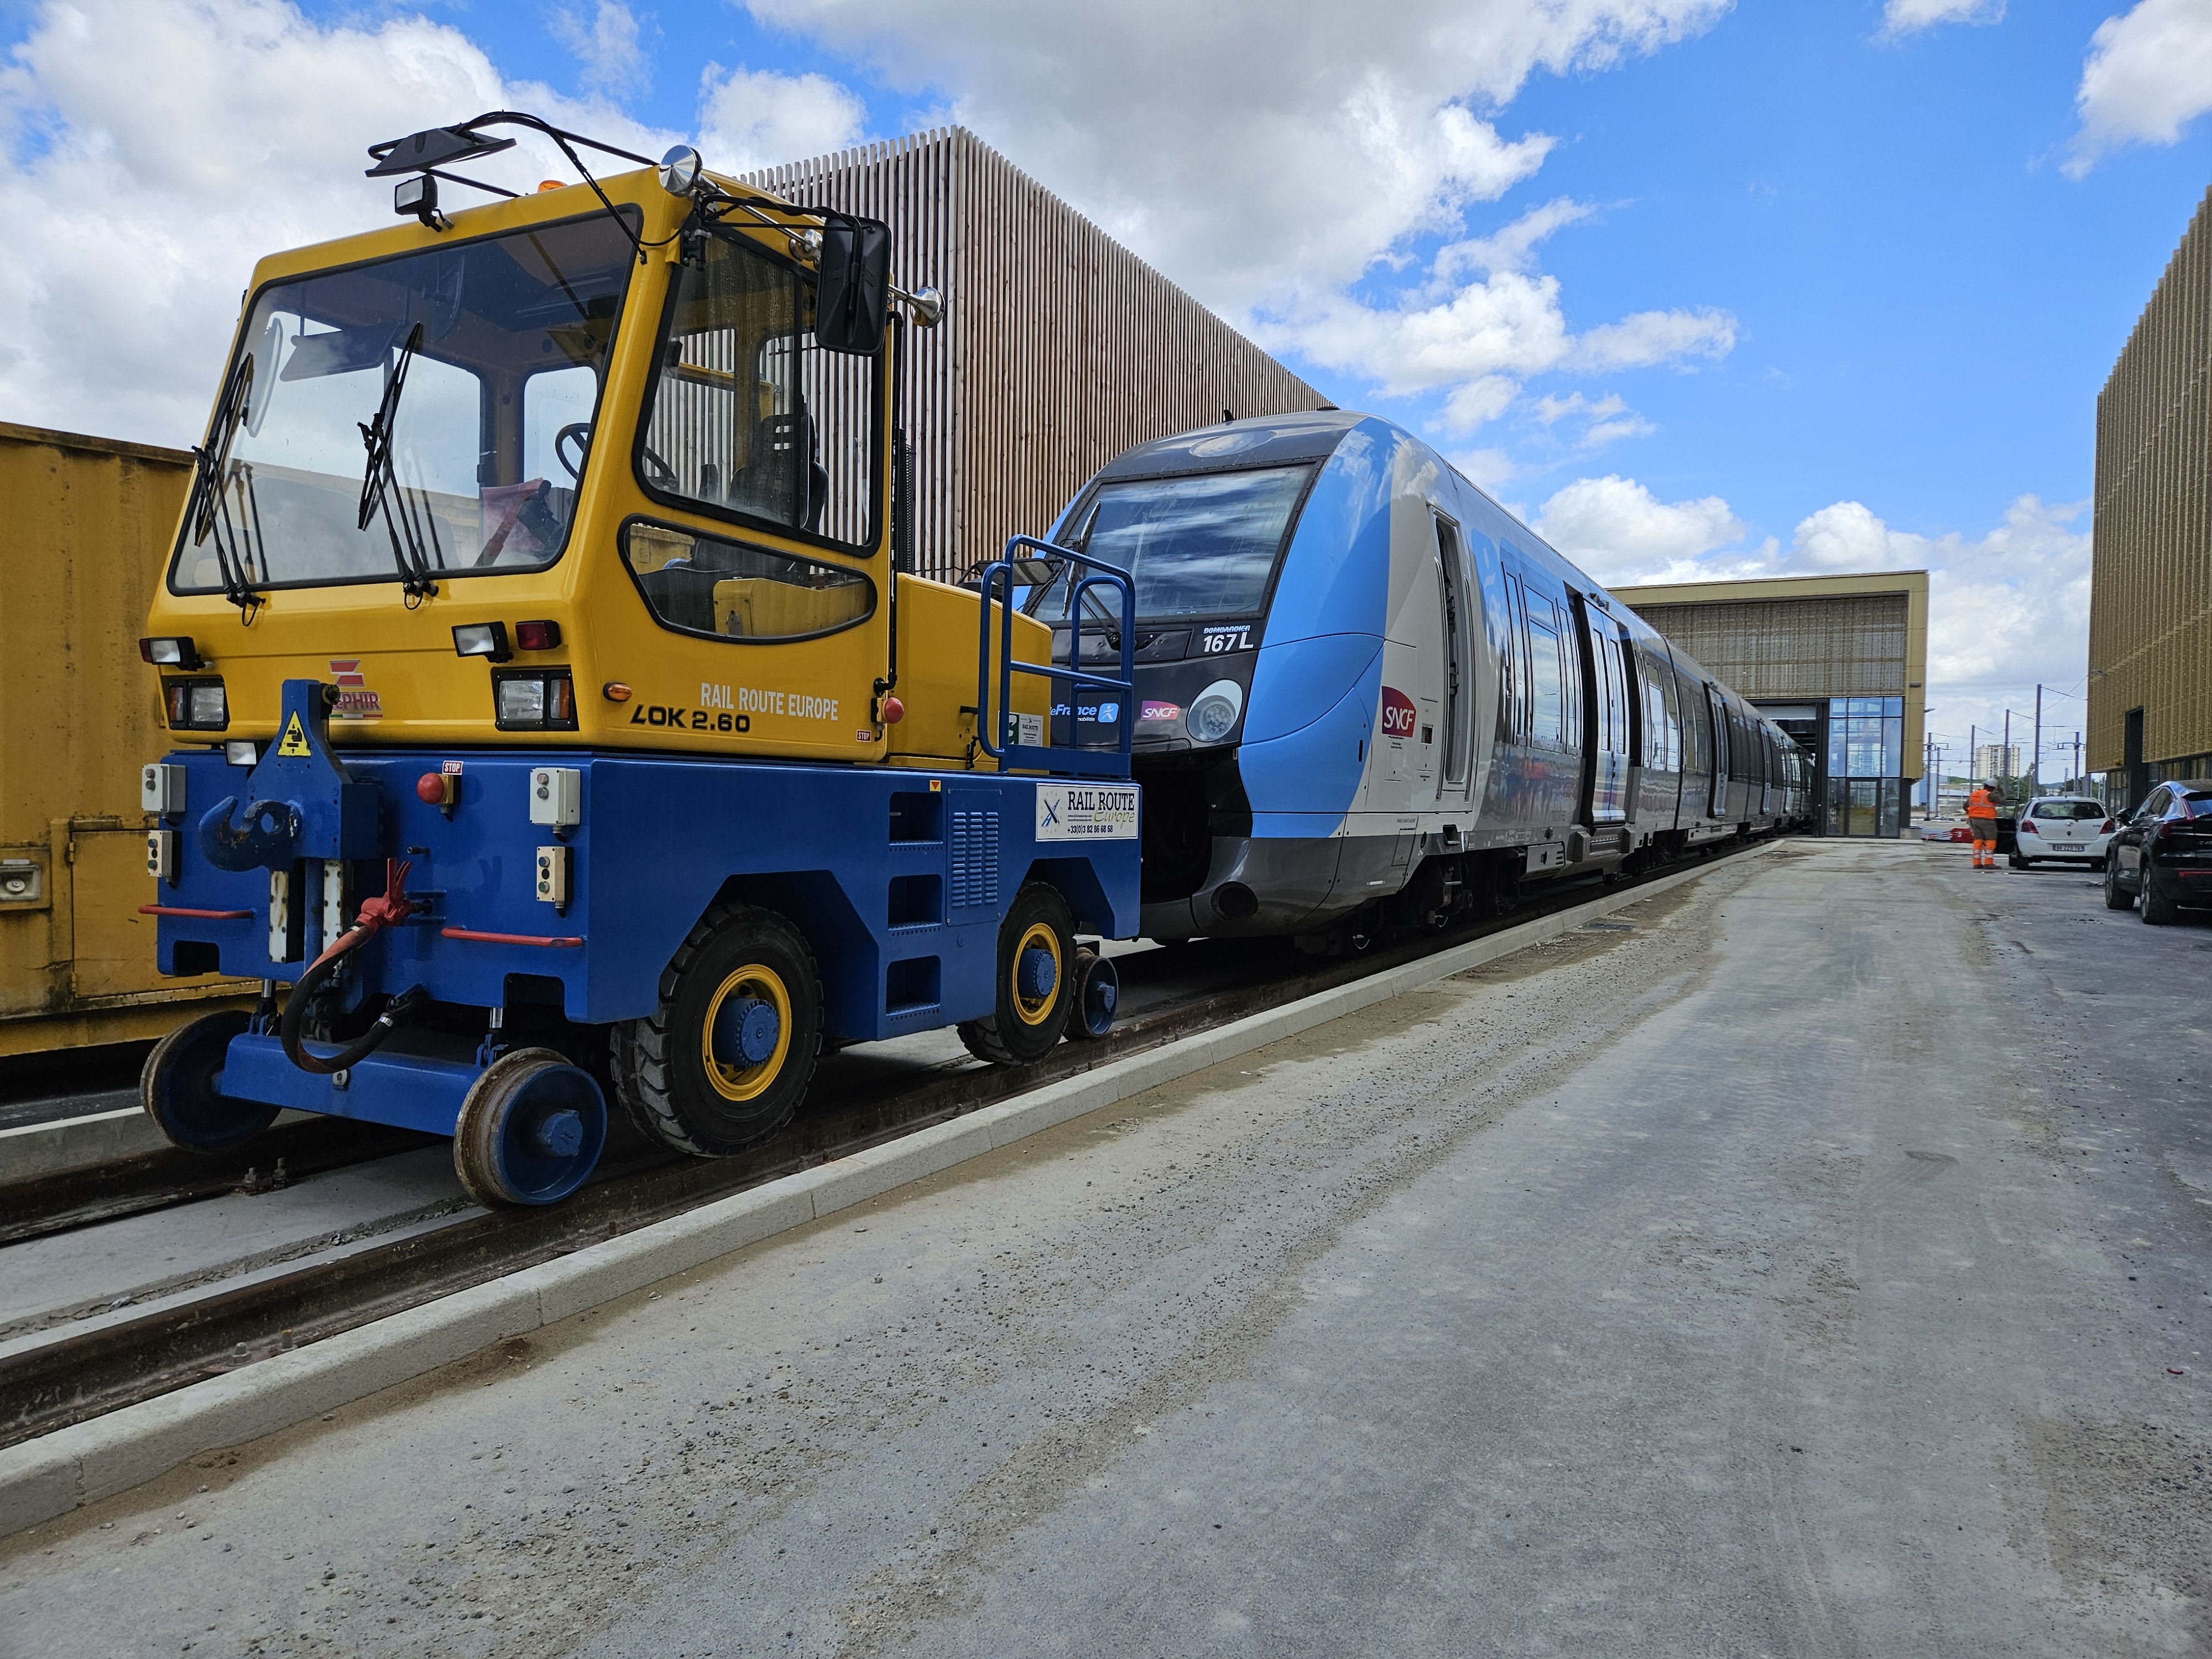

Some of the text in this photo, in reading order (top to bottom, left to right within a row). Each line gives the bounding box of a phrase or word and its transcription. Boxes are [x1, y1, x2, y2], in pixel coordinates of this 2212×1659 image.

[1203, 625, 1250, 634] BOMBARDIER
[333, 692, 380, 710] EPHIR
[701, 682, 838, 721] RAIL ROUTE EUROPE
[629, 704, 750, 733] LOK 2.60
[1142, 708, 1178, 718] SNCF
[1384, 706, 1415, 731] SNCF
[858, 732, 870, 740] STOP
[444, 763, 460, 772] STOP
[1068, 791, 1135, 811] RAIL ROUTE
[1094, 804, 1135, 829] Europe
[1087, 825, 1093, 833] 82
